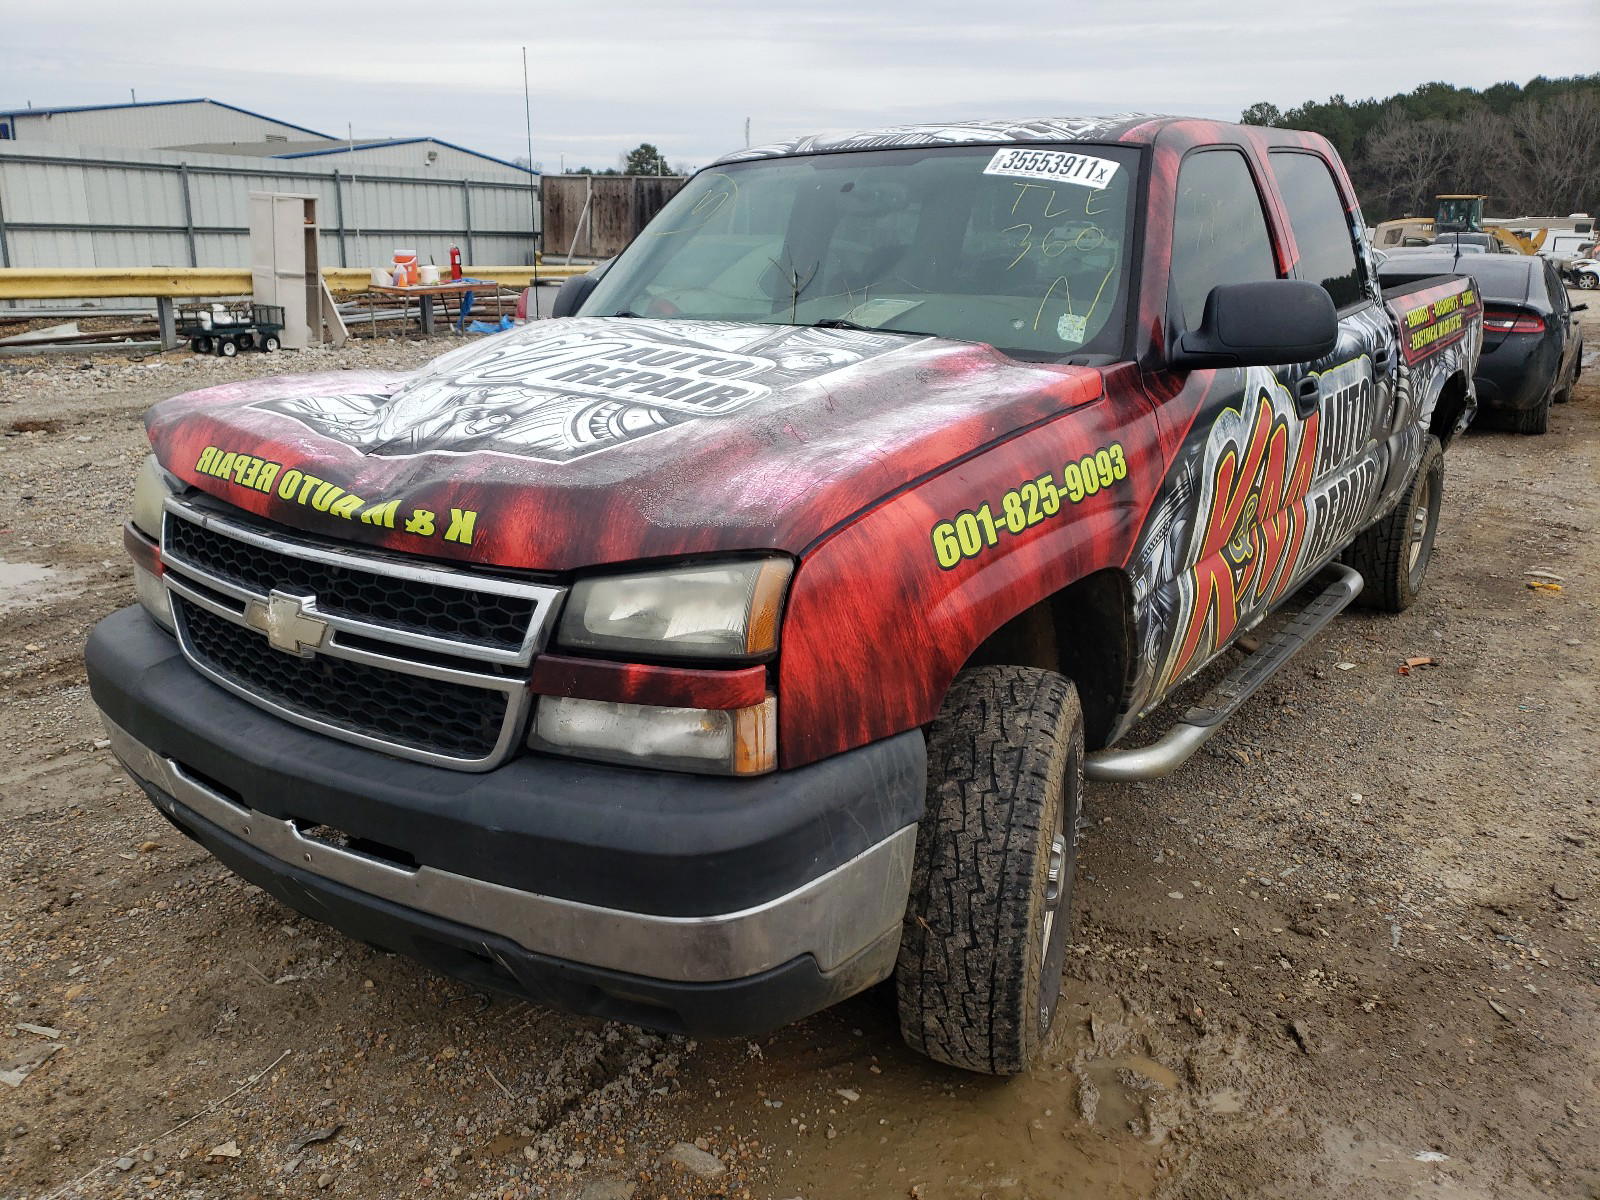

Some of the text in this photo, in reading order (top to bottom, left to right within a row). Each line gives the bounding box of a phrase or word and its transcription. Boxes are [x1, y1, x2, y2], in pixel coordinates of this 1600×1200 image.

[1002, 223, 1104, 271] 360
[600, 346, 757, 377] AUTO
[547, 363, 753, 409] REPAIR
[1314, 377, 1371, 482] AUTO
[931, 443, 1128, 570] 601-825-9093
